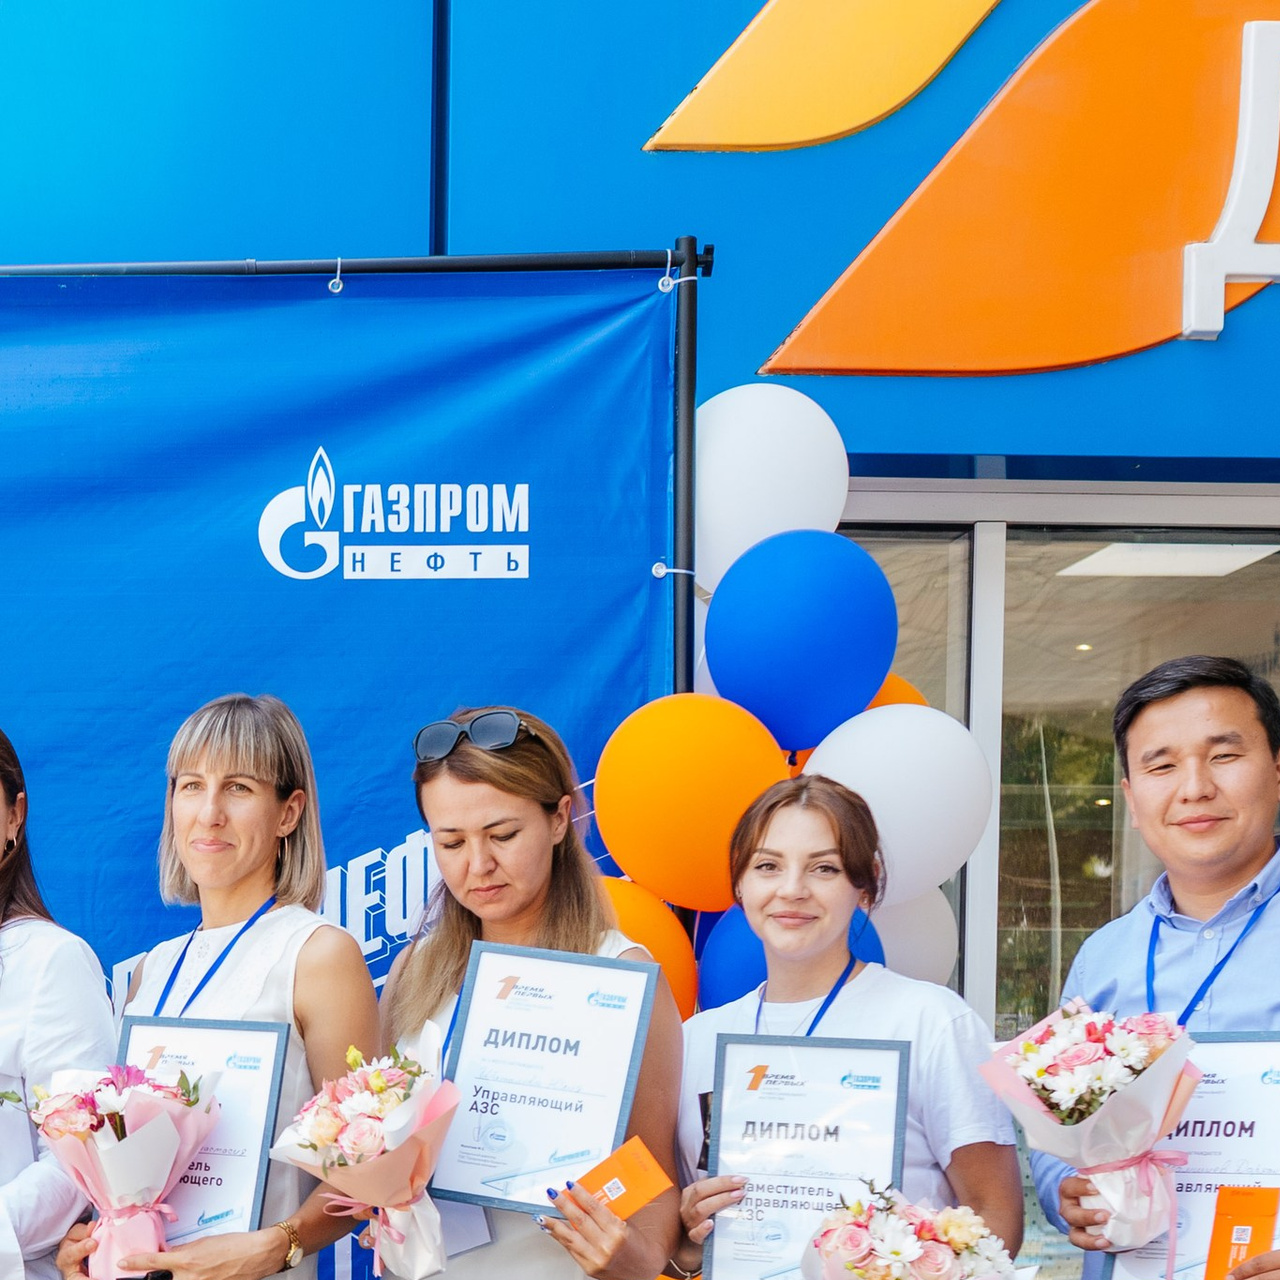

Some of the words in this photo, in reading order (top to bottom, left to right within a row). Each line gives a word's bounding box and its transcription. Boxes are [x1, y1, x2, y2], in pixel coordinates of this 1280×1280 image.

[343, 483, 529, 533] ГАЗПРОМ
[351, 551, 520, 573] НЕФТЬ
[483, 1028, 581, 1057] ДИПЛОМ
[468, 1100, 501, 1117] АЗС
[472, 1084, 584, 1114] Управляющий
[741, 1121, 840, 1142] ДИПЛОМ
[1166, 1120, 1256, 1140] ИПЛОМ
[740, 1182, 834, 1198] аместитель
[737, 1197, 840, 1212] правляюще
